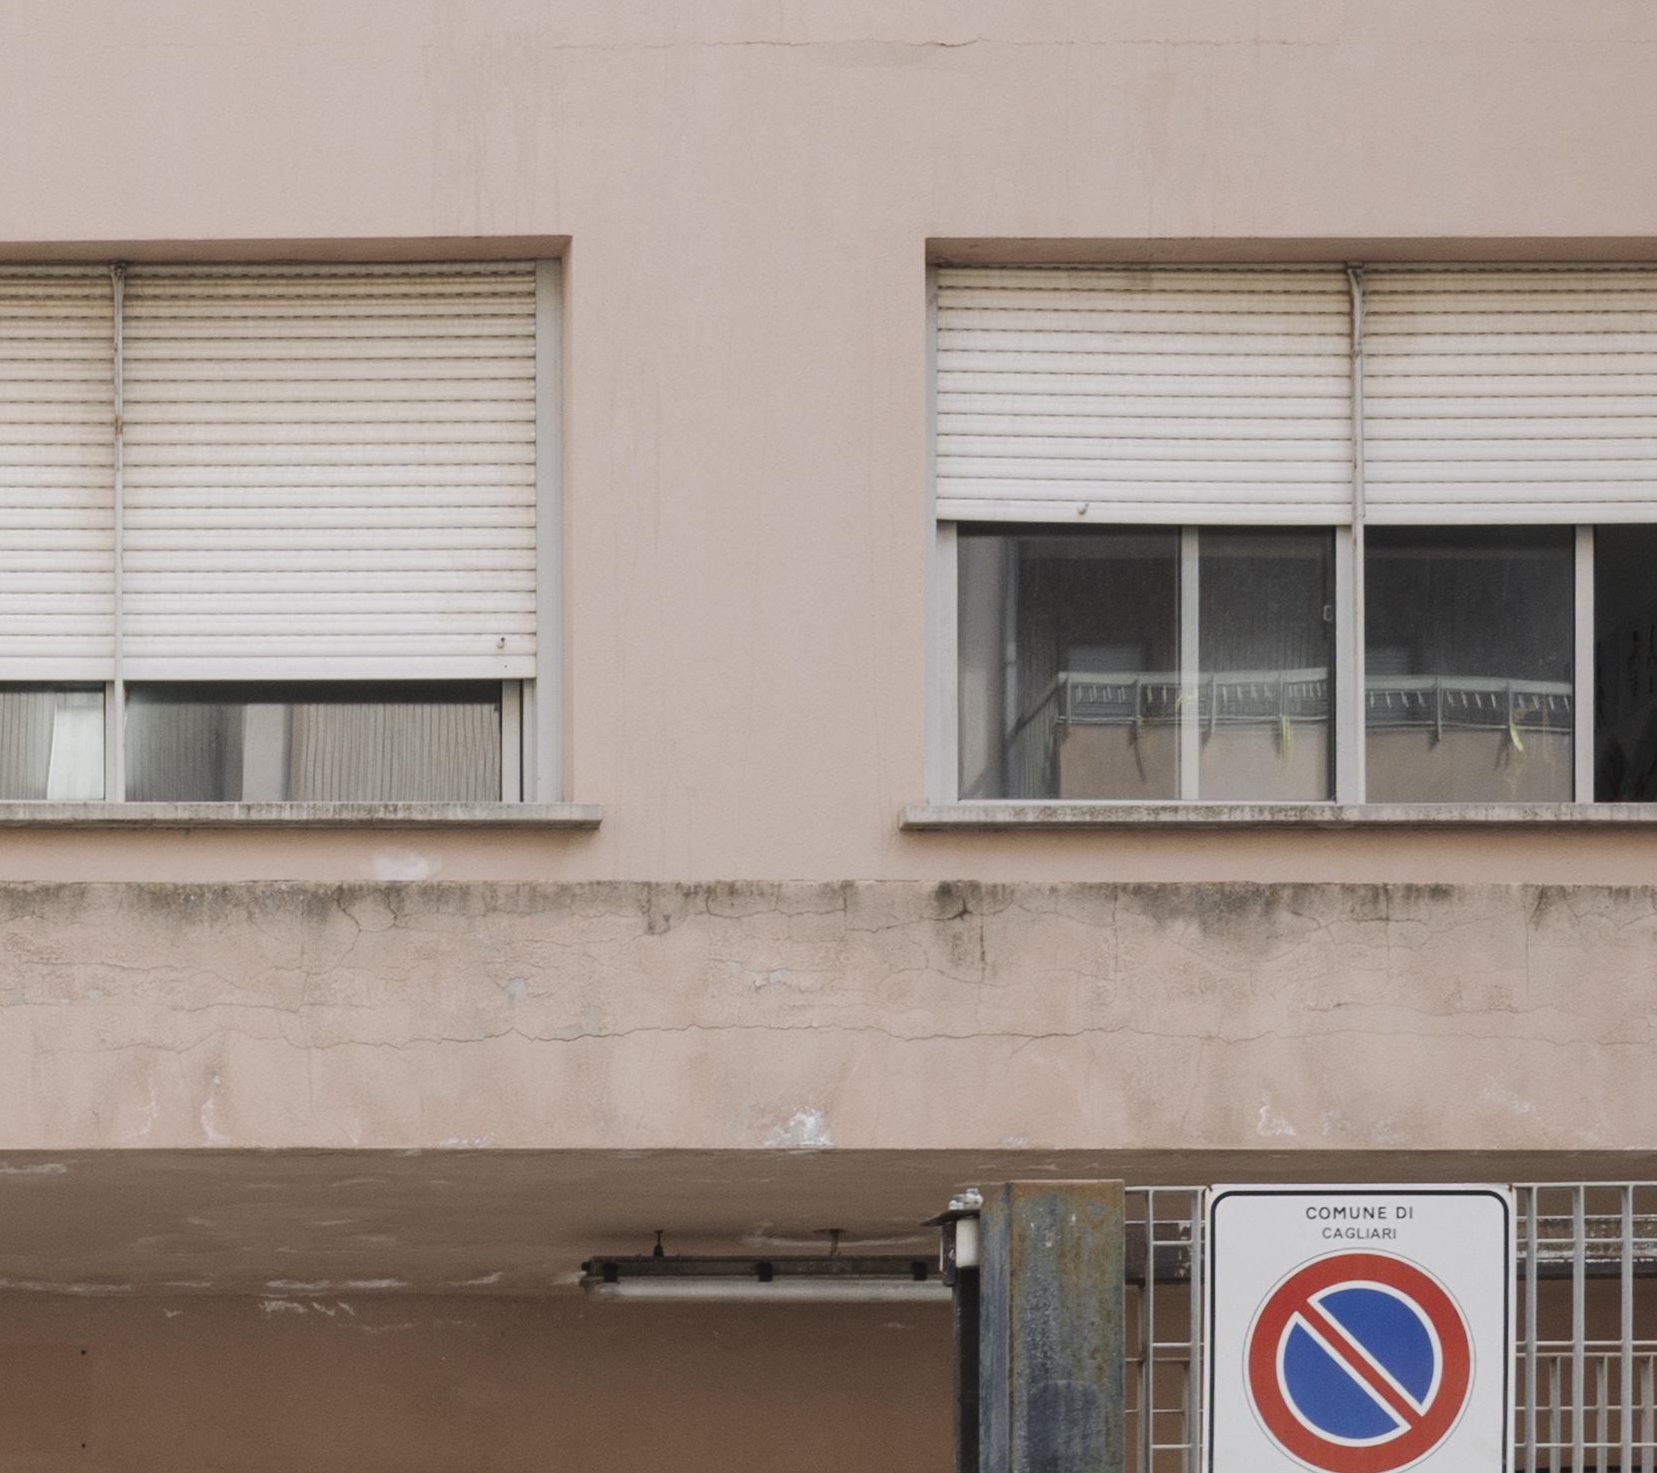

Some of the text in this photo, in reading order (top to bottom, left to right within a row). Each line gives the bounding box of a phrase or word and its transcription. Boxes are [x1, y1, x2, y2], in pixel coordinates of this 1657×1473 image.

[1305, 1206, 1413, 1220] COMUNE DI
[1321, 1227, 1397, 1239] CAGLIARI
